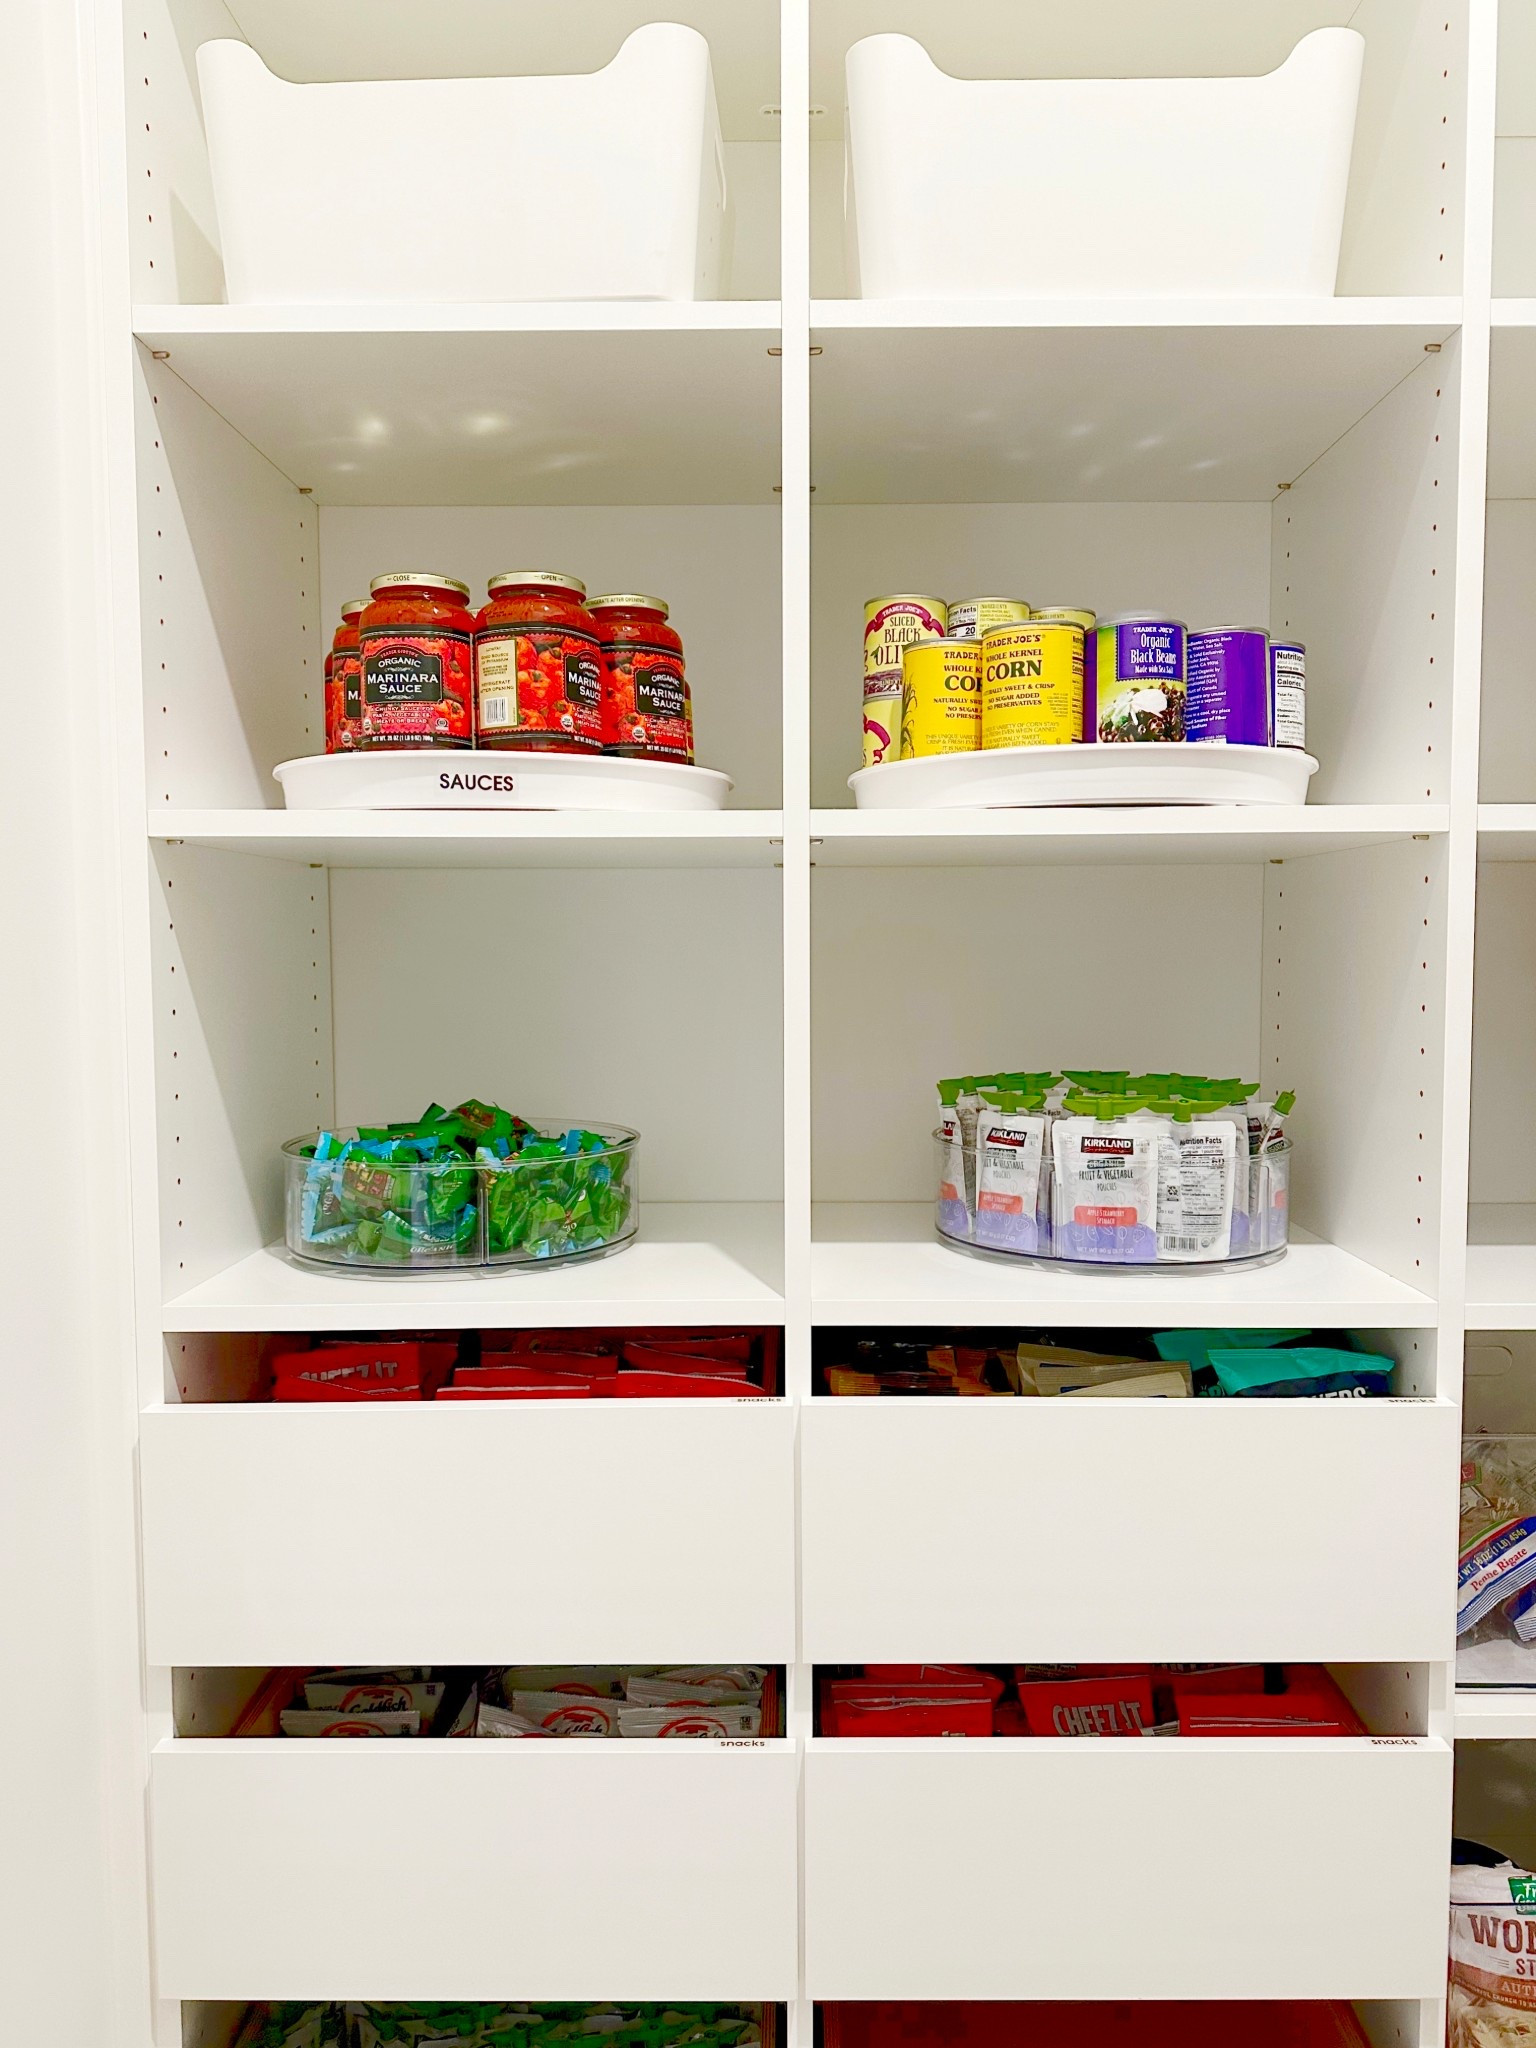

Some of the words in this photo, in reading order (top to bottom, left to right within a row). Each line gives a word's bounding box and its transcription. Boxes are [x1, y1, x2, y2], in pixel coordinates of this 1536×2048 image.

[889, 616, 916, 627] SLICED
[884, 627, 921, 643] BLACK
[965, 626, 976, 635] 20
[986, 637, 1012, 650] TRADER
[1013, 634, 1041, 644] JOE'S
[1140, 633, 1171, 650] Organic
[944, 651, 979, 661] TRADER
[1009, 649, 1043, 658] KERNEL
[1130, 649, 1154, 664] Black
[1156, 648, 1177, 665] Beans
[378, 657, 422, 668] ORGANIC
[986, 659, 1042, 683] CORN
[1135, 665, 1148, 674] Made
[1148, 664, 1159, 673] with
[1158, 665, 1166, 673] Sea
[1166, 665, 1174, 674] Salt
[367, 673, 439, 685] MARINARA
[651, 674, 681, 688] ORGANIC
[1276, 678, 1302, 687] Calories
[379, 684, 422, 693] SAUCE
[1004, 684, 1026, 692] SWEET
[995, 693, 1014, 703] SUGAR
[1015, 692, 1040, 700] ADDED
[652, 697, 682, 711] SAUCE
[993, 699, 1042, 710] PRESERVATIVES
[439, 773, 514, 792] SAUCES
[1084, 1138, 1132, 1149] KIRKLAND
[1205, 1136, 1222, 1145] Facts
[1079, 1170, 1096, 1181] FRUIT
[1096, 1170, 1102, 1179] &
[1103, 1169, 1134, 1179] VEGETABLE
[1509, 1528, 1528, 1542] 454g
[1471, 1569, 1499, 1591] Penne
[1497, 1548, 1528, 1572] Rigate
[1052, 1704, 1116, 1736] CHEEZ
[720, 1739, 766, 1747] snacks
[1370, 1737, 1418, 1746] snacks
